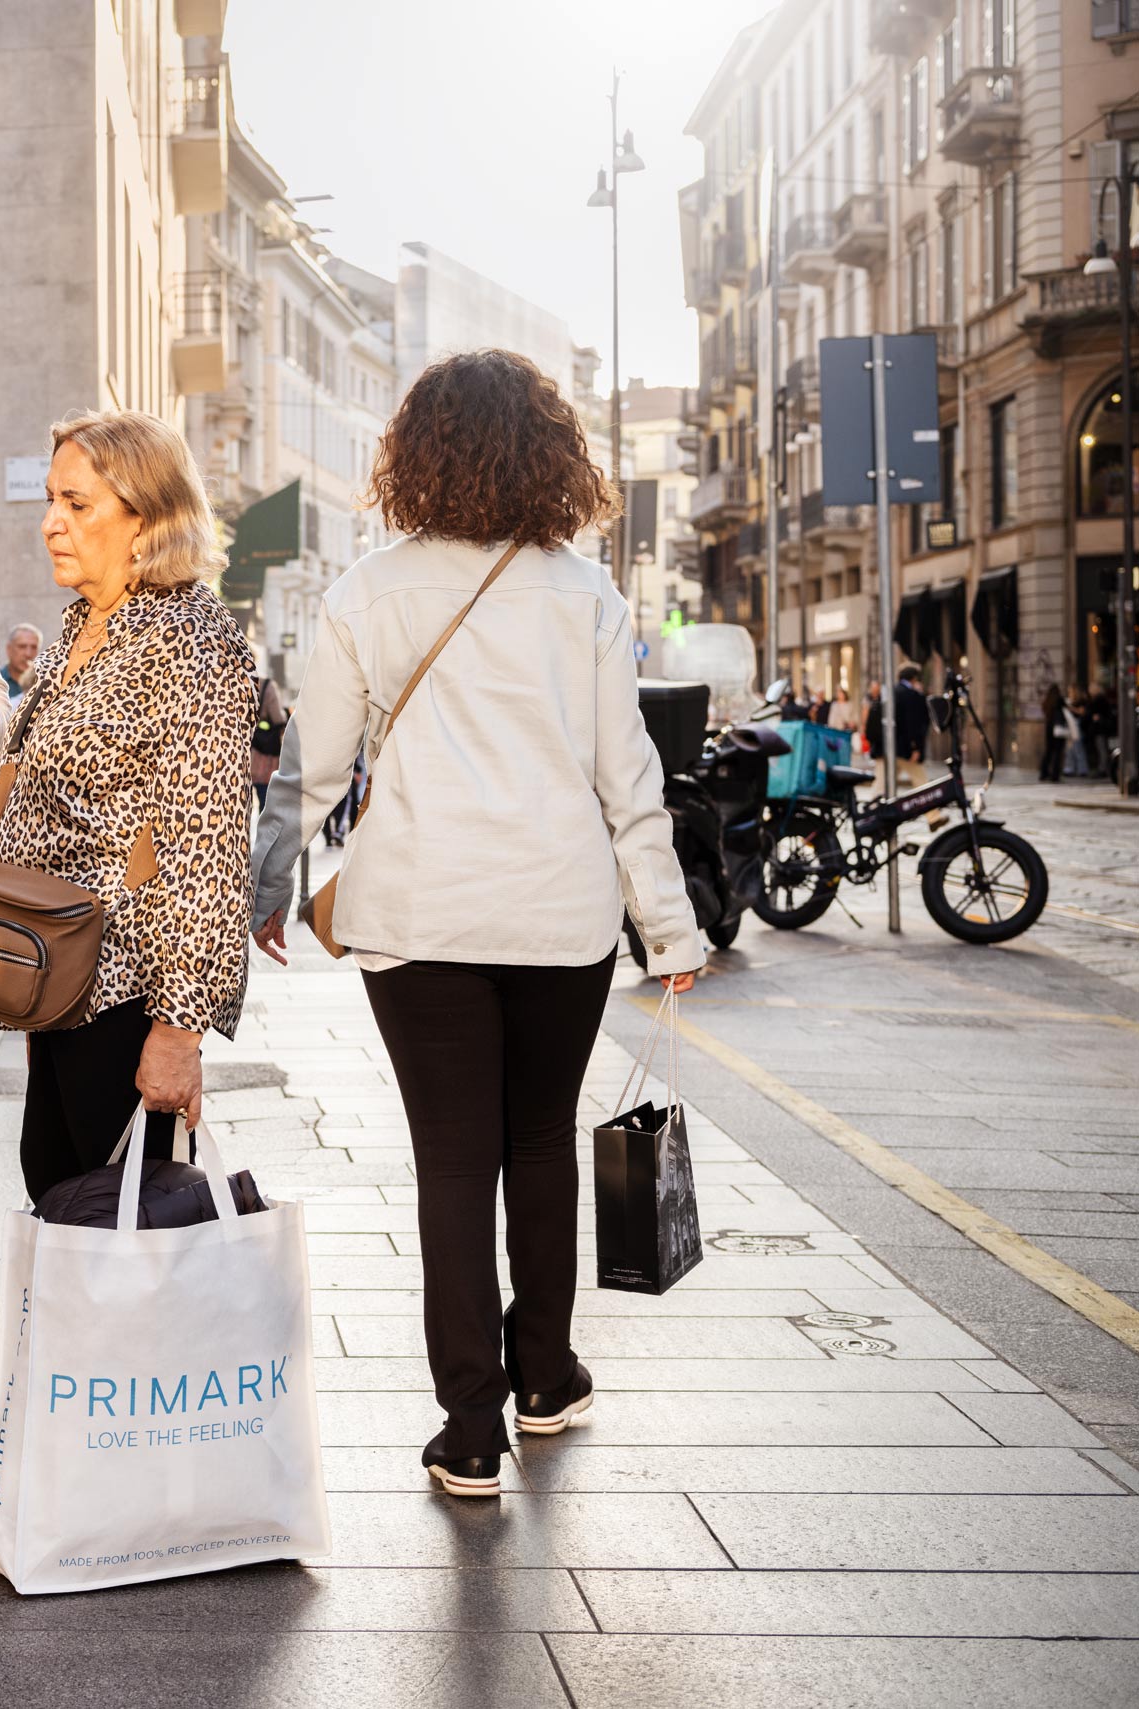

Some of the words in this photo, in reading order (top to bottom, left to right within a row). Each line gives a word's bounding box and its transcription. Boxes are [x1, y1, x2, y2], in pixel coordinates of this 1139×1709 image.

[50, 1356, 288, 1417] PRIMARK
[87, 1431, 138, 1449] LOVE
[146, 1428, 182, 1447] THE
[189, 1417, 265, 1443] FEELING
[59, 1557, 93, 1568] MADE
[96, 1554, 130, 1566] FROM
[134, 1549, 164, 1562] 100%
[167, 1540, 225, 1556] RECYCLED
[227, 1534, 291, 1547] POLYESTER
